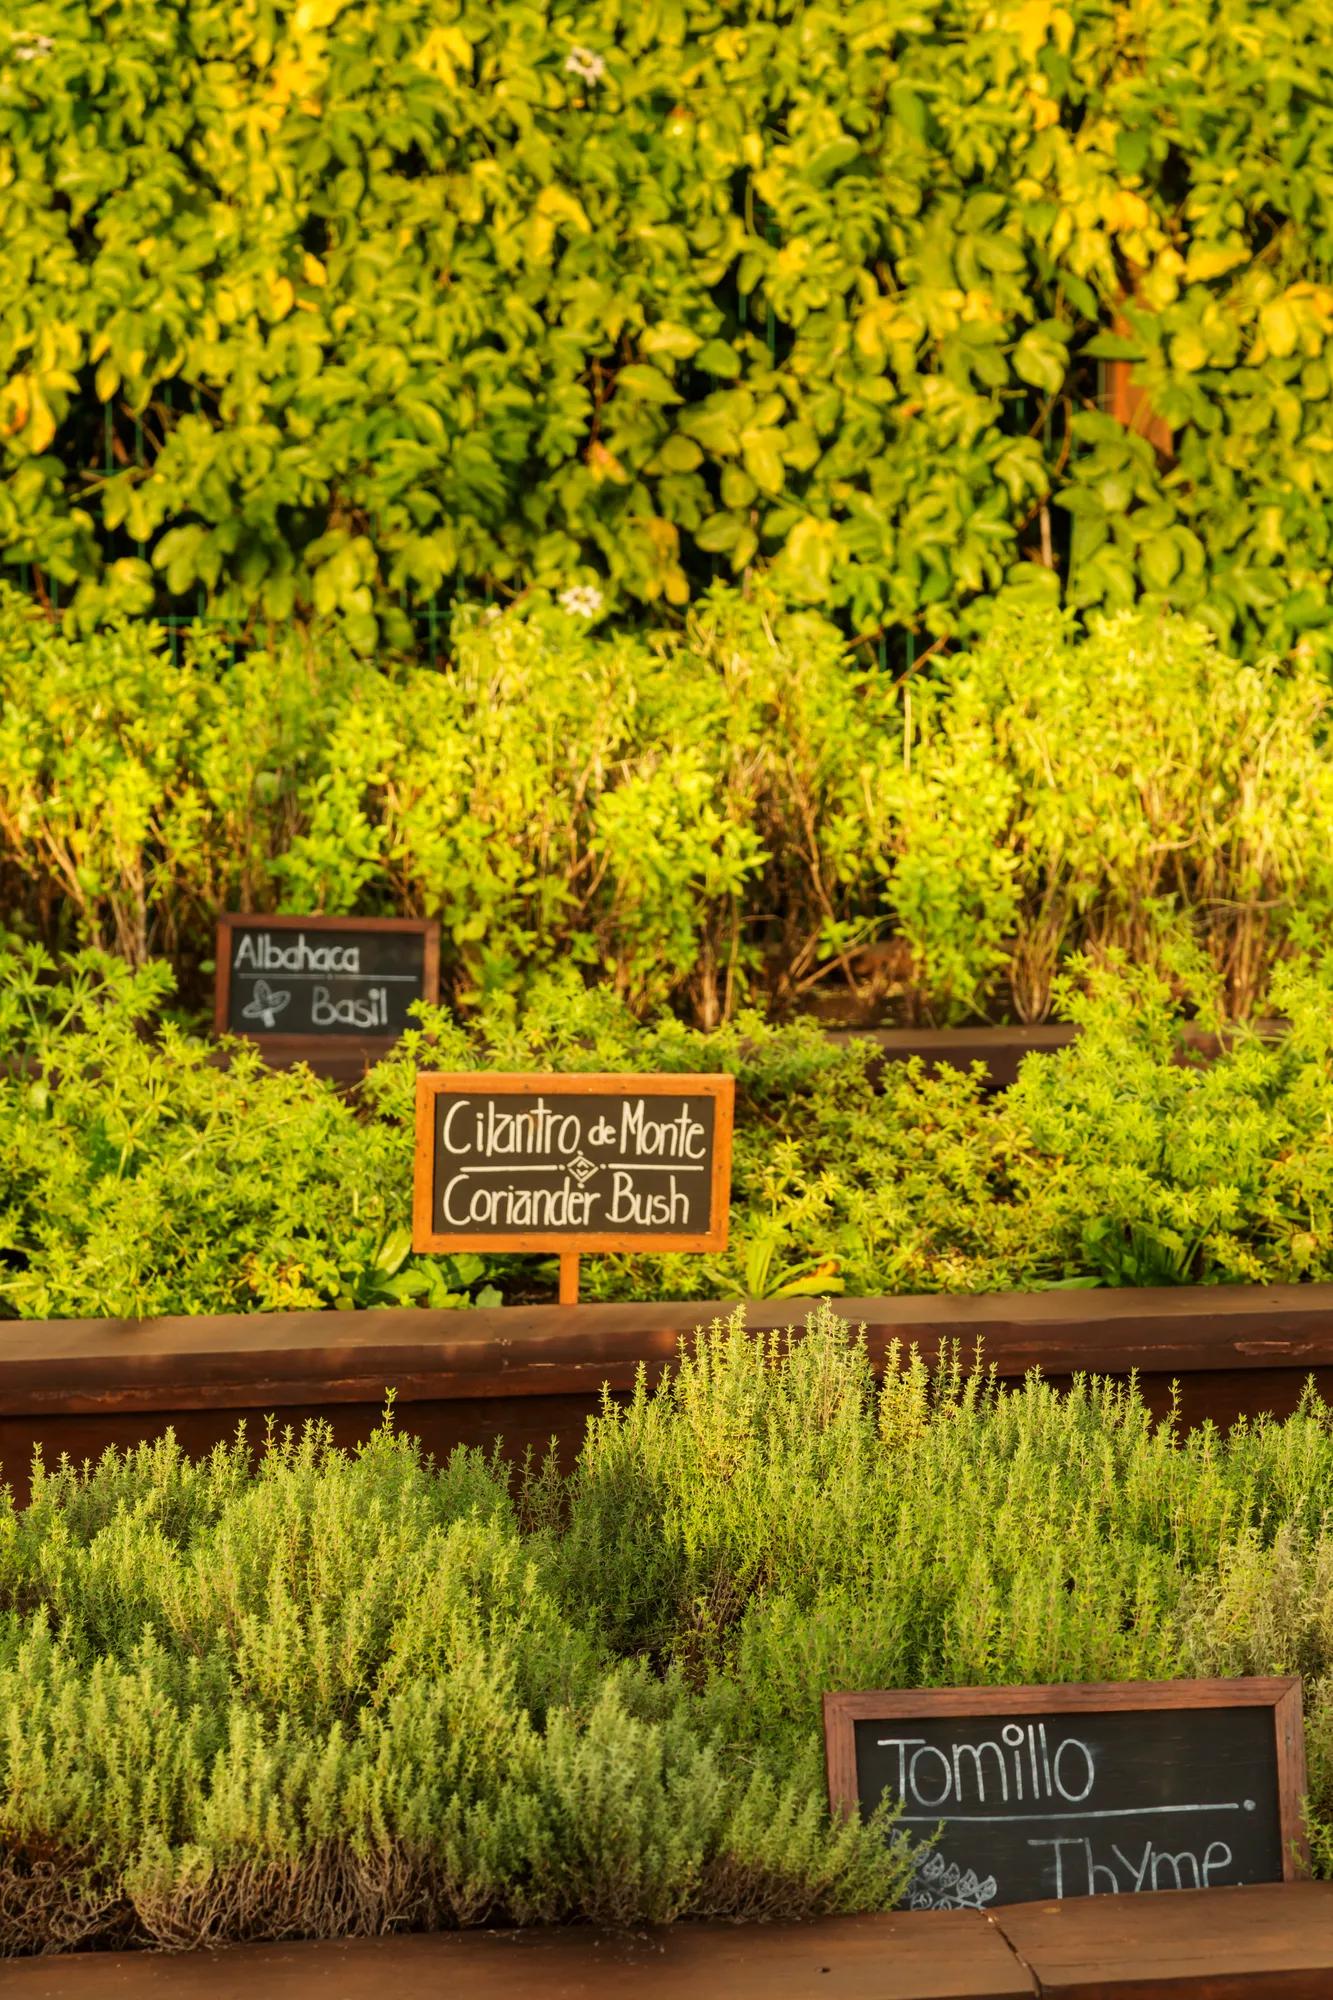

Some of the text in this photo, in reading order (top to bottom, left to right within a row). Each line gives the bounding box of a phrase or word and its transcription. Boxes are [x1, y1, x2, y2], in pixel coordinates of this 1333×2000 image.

[233, 933, 360, 973] Albahaca
[311, 985, 388, 1028] Basil
[443, 1097, 706, 1159] Cilantro de Monte
[442, 1171, 690, 1226] Coriander Bush
[877, 1722, 1096, 1807] Tomillo
